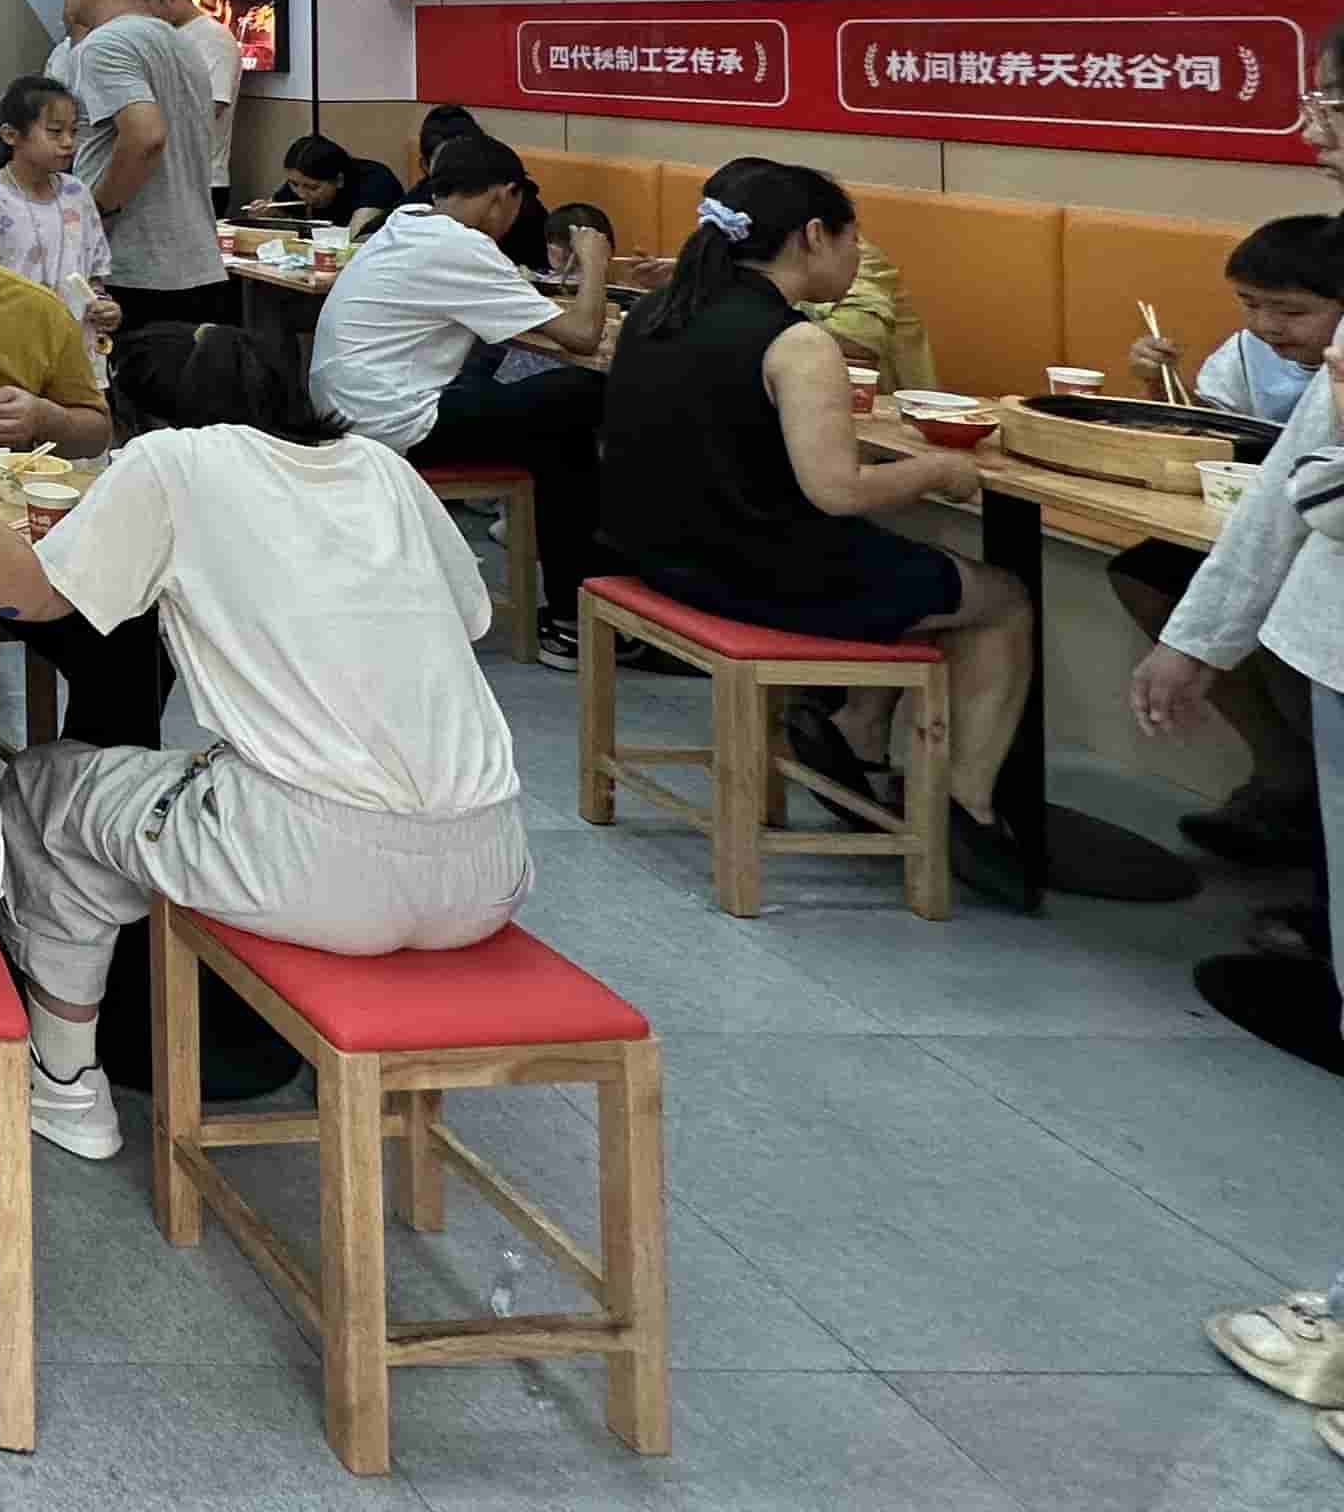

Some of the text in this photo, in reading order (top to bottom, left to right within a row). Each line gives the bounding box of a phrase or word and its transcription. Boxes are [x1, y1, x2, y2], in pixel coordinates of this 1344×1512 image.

[548, 45, 745, 77] 四代秘制工艺传承
[886, 49, 1224, 92] 林间散养天然谷饲
